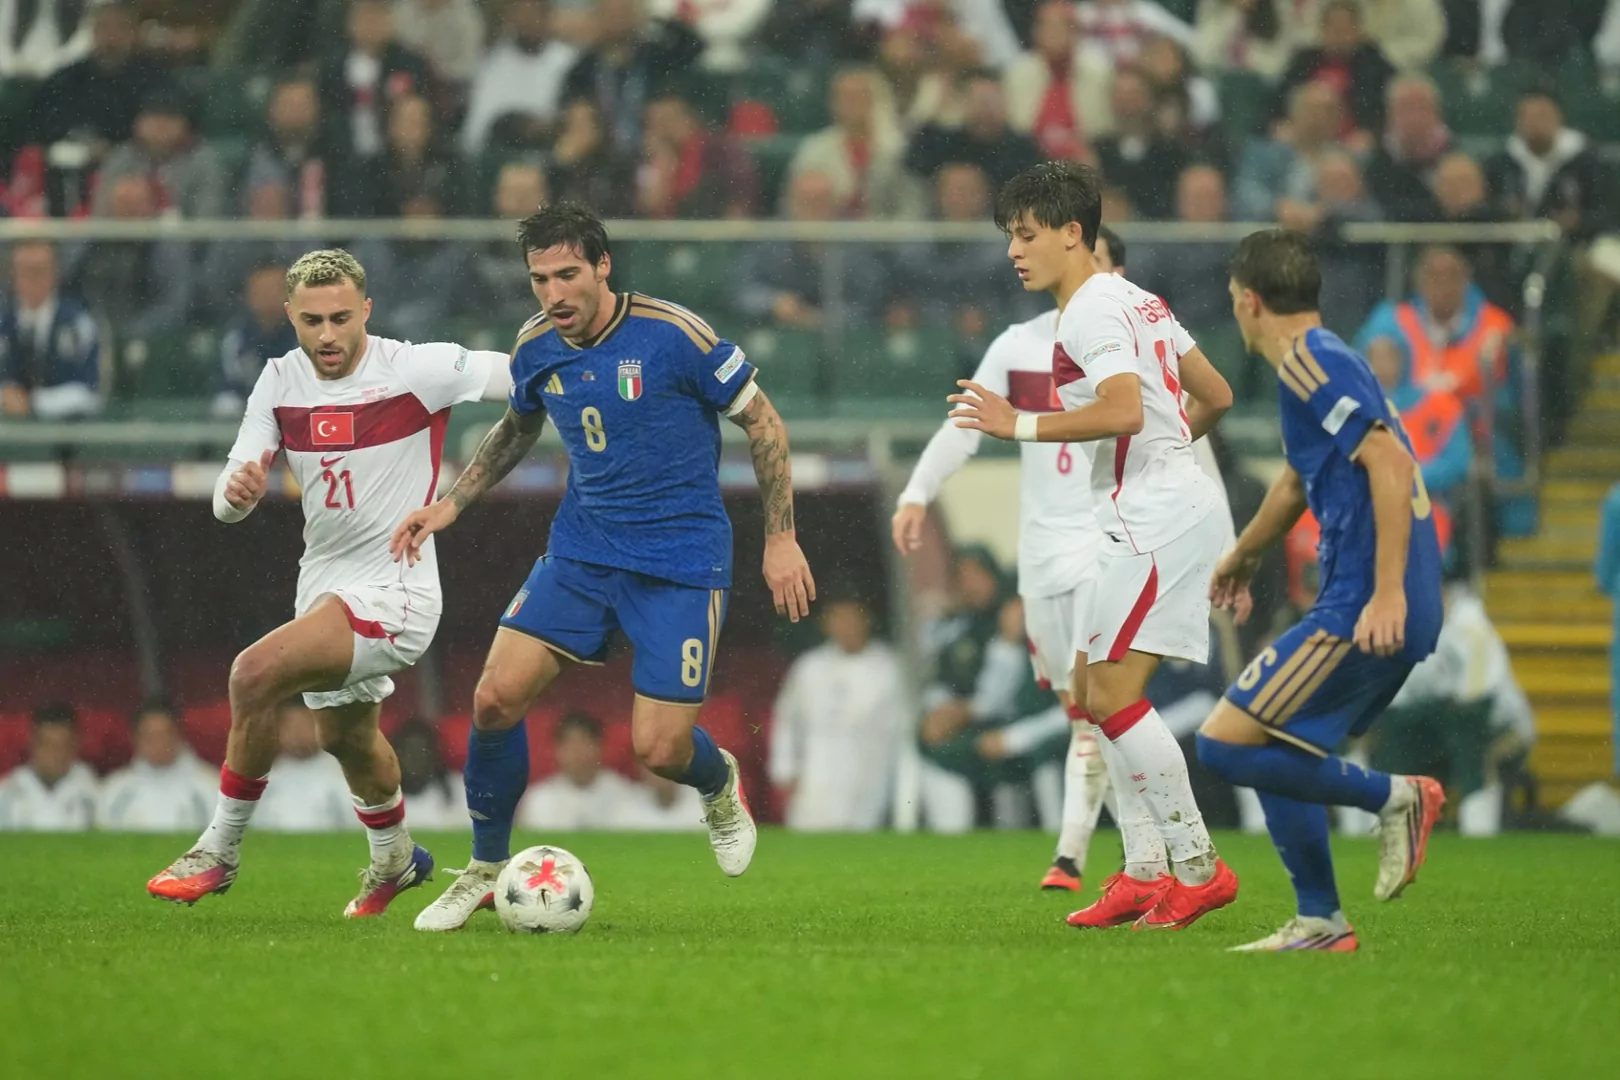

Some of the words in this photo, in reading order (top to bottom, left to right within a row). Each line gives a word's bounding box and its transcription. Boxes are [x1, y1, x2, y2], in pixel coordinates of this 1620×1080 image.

[581, 406, 607, 452] 8
[1057, 442, 1072, 475] 6
[323, 469, 355, 509] 21
[681, 638, 703, 687] 8
[1237, 646, 1278, 691] 6
